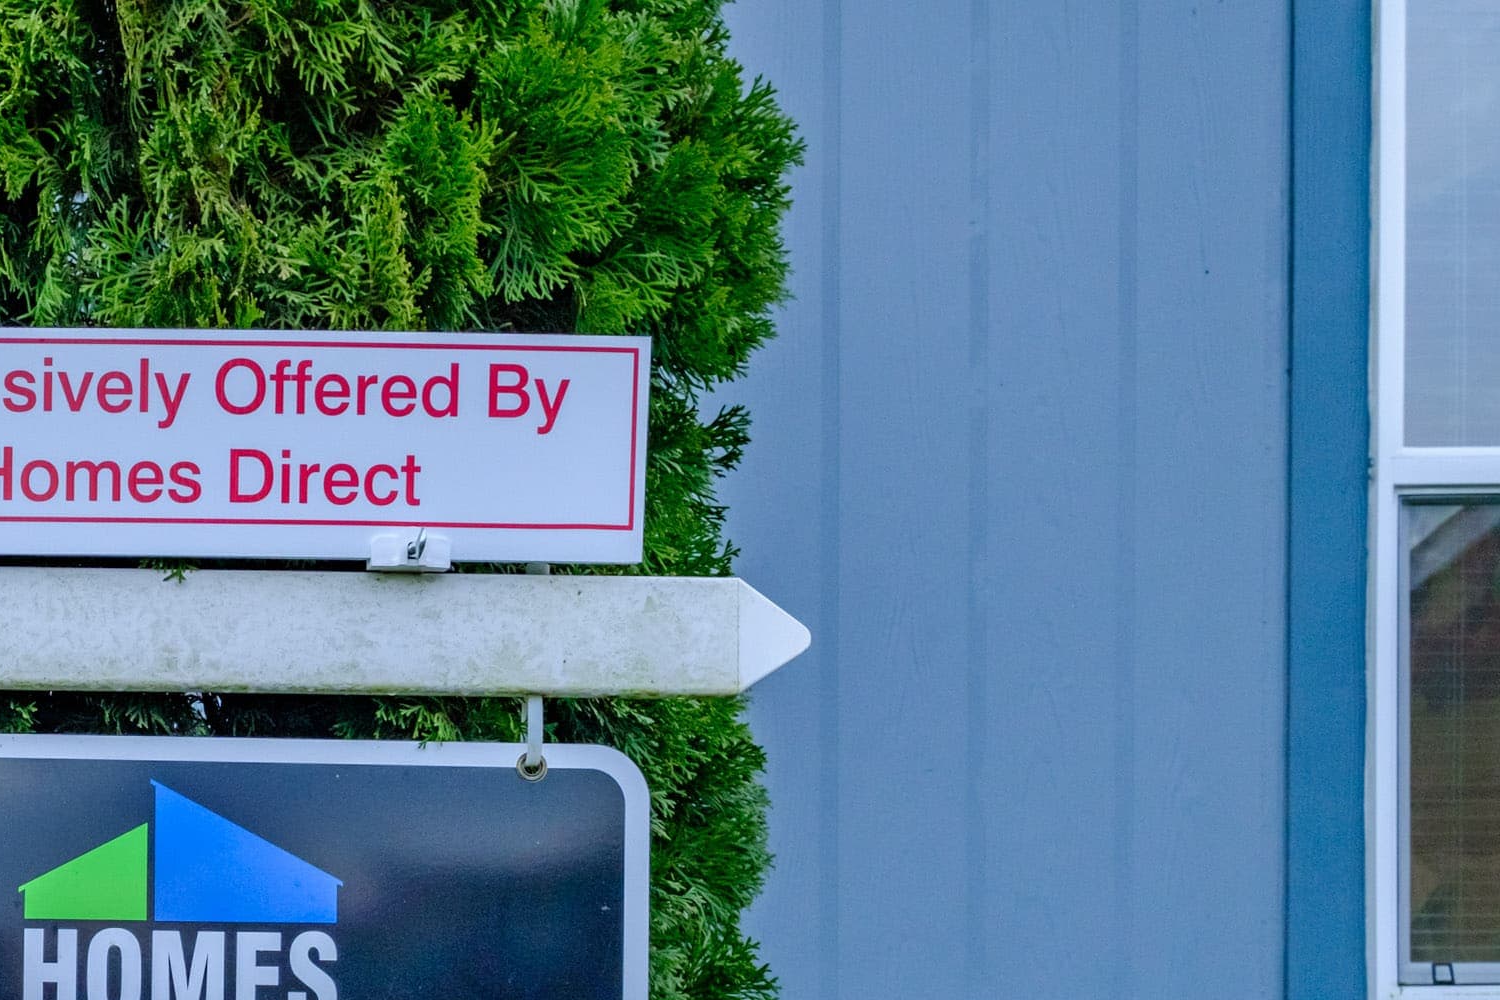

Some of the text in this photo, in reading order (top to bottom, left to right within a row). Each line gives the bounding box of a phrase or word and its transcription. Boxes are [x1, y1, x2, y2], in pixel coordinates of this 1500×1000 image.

[215, 358, 459, 418] Offered
[488, 364, 569, 434] By
[230, 449, 420, 506] Direct
